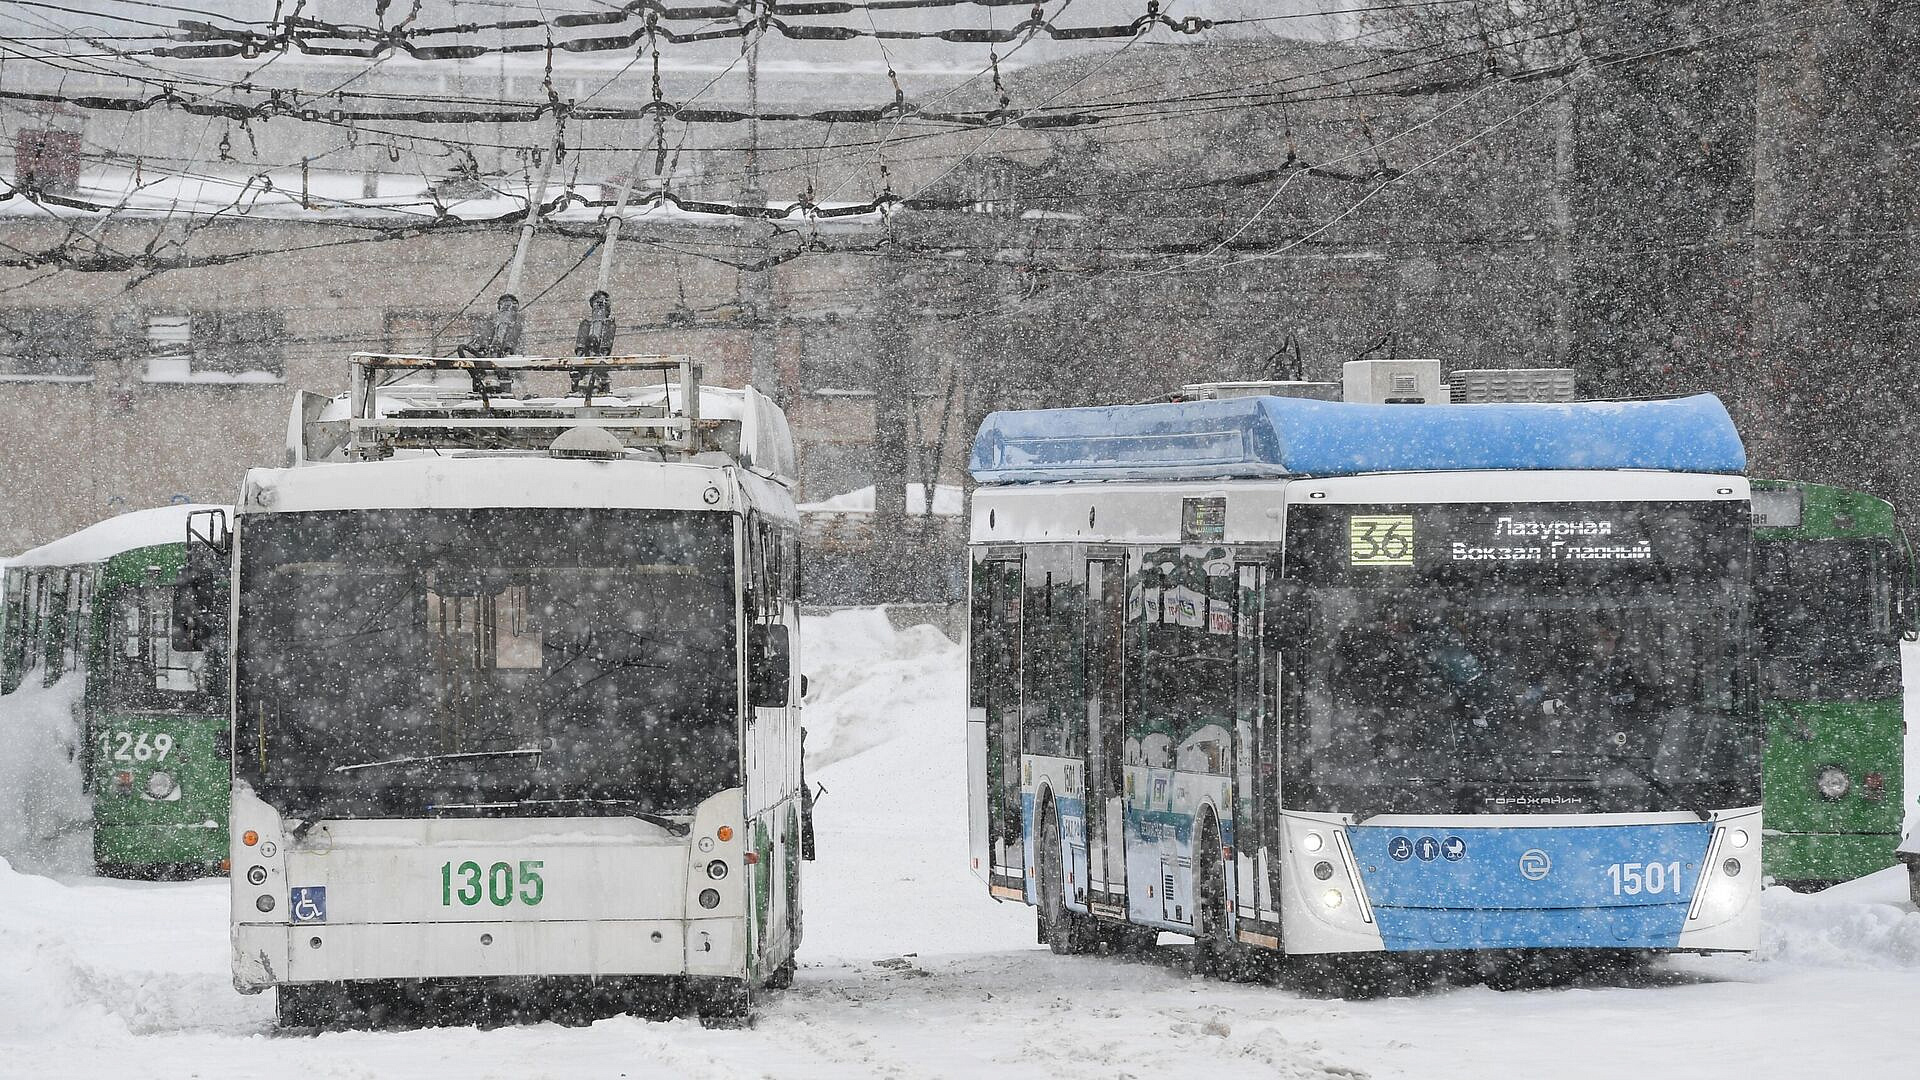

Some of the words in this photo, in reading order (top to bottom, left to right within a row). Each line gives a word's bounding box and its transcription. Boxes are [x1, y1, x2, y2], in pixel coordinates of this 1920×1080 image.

[1353, 519, 1409, 560] 36
[1494, 516, 1612, 540] Лазурная
[1453, 542, 1541, 560] Вокзал
[1551, 540, 1651, 560] Главный
[99, 731, 173, 762] 1269
[441, 860, 544, 907] 1305
[1606, 861, 1681, 896] 1501
